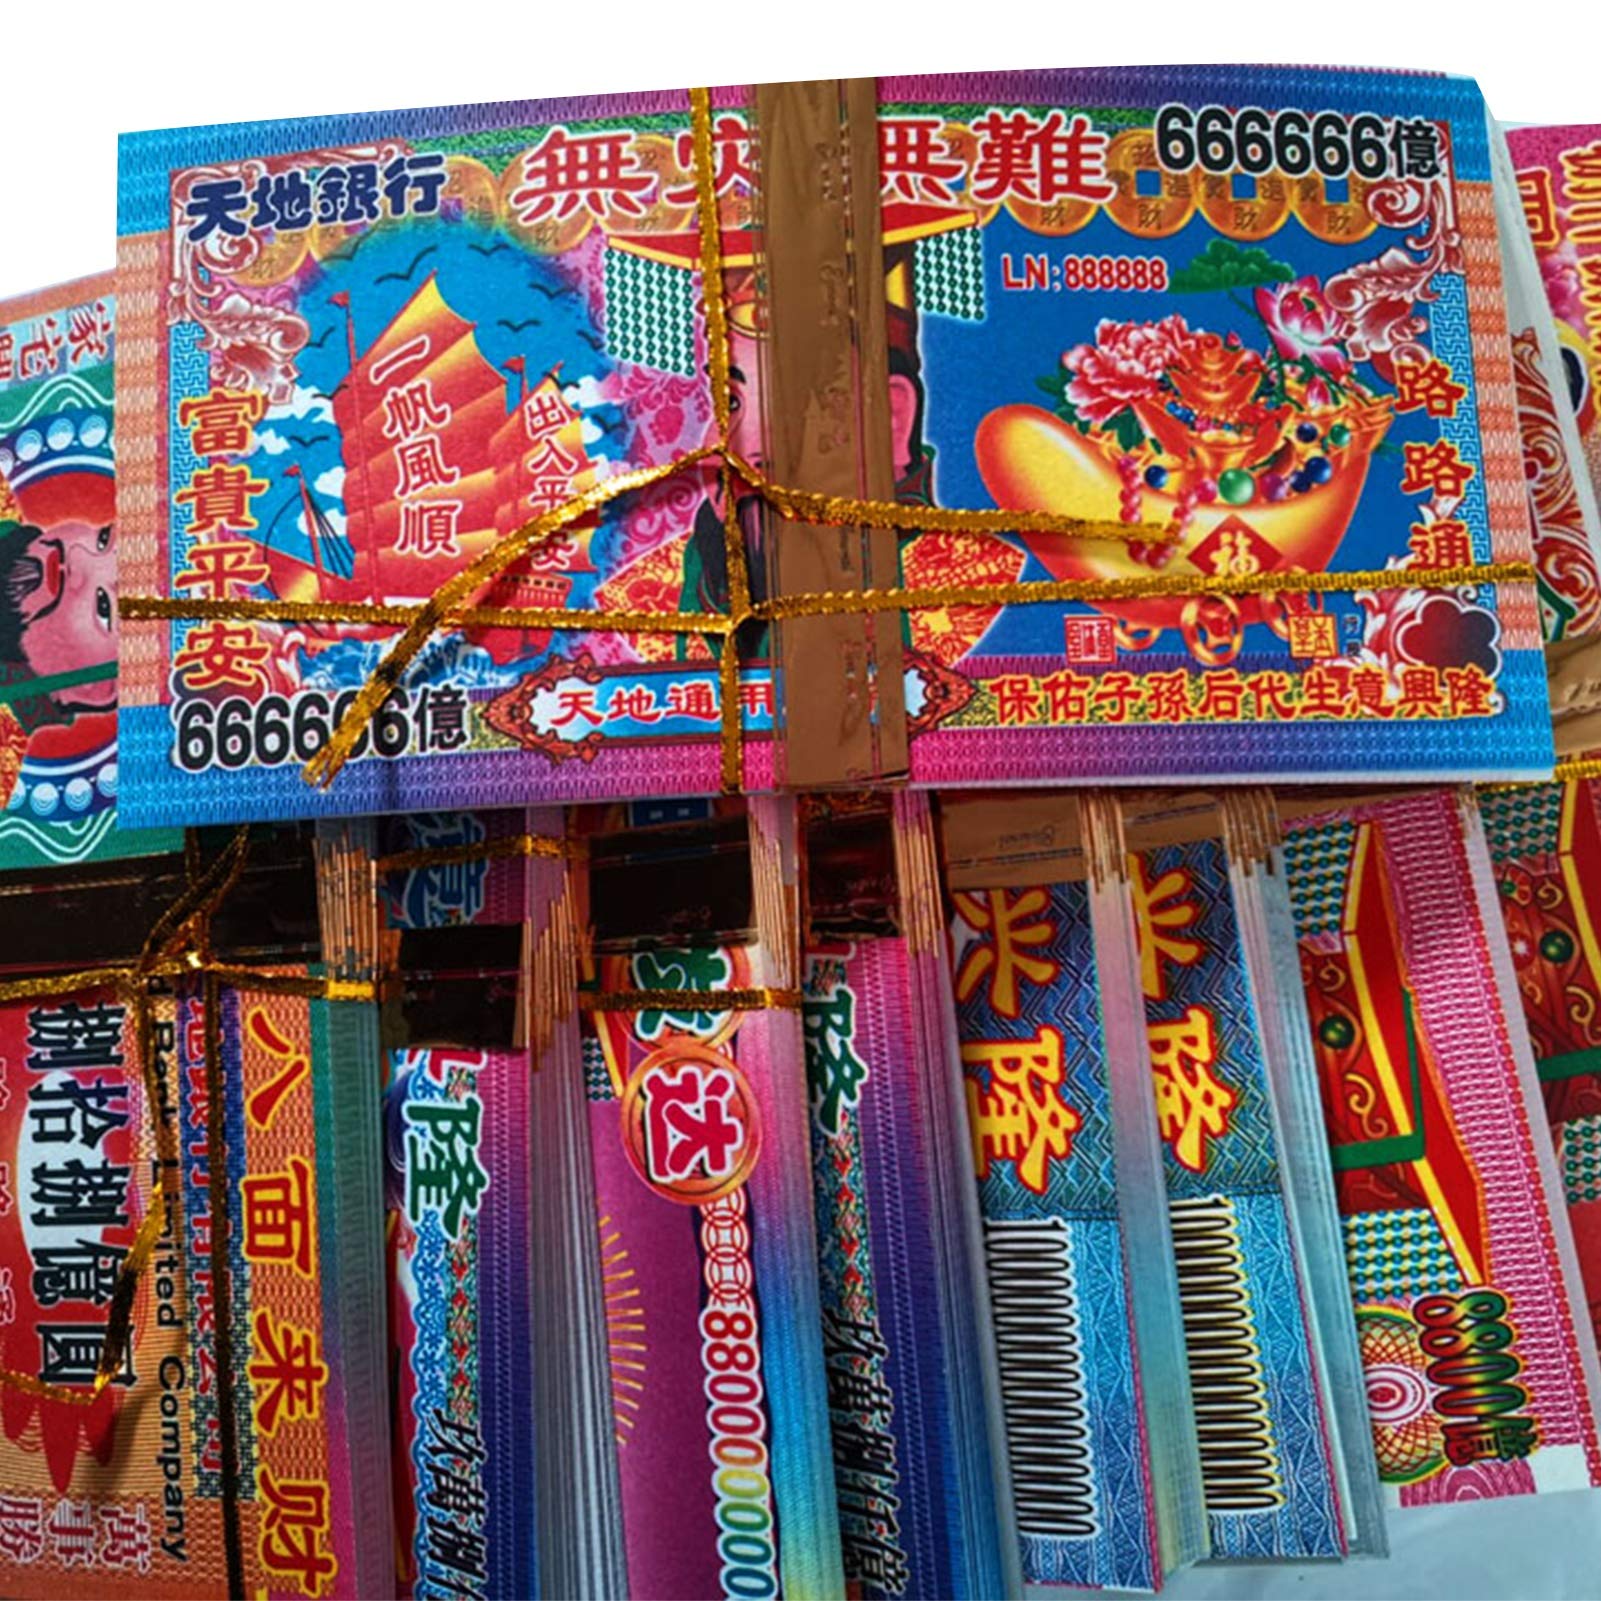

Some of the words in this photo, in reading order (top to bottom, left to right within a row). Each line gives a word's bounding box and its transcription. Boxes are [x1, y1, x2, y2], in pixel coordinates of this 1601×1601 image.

[186, 153, 446, 242] 天地銀行
[1156, 104, 1440, 180] 666666億
[175, 390, 271, 690] 富貴平安
[370, 333, 460, 558] 一帆風順
[524, 393, 580, 570] 出入平安
[1394, 360, 1474, 571] 路路通
[989, 664, 1496, 725] 保佑子孫后代生意興隆
[26, 1000, 138, 1388] 捌拾捌億圓
[245, 1006, 338, 1598] 八面来财
[1412, 1288, 1538, 1468] 8800億
[157, 1356, 189, 1562] Company
[702, 1310, 777, 1599] 880000000
